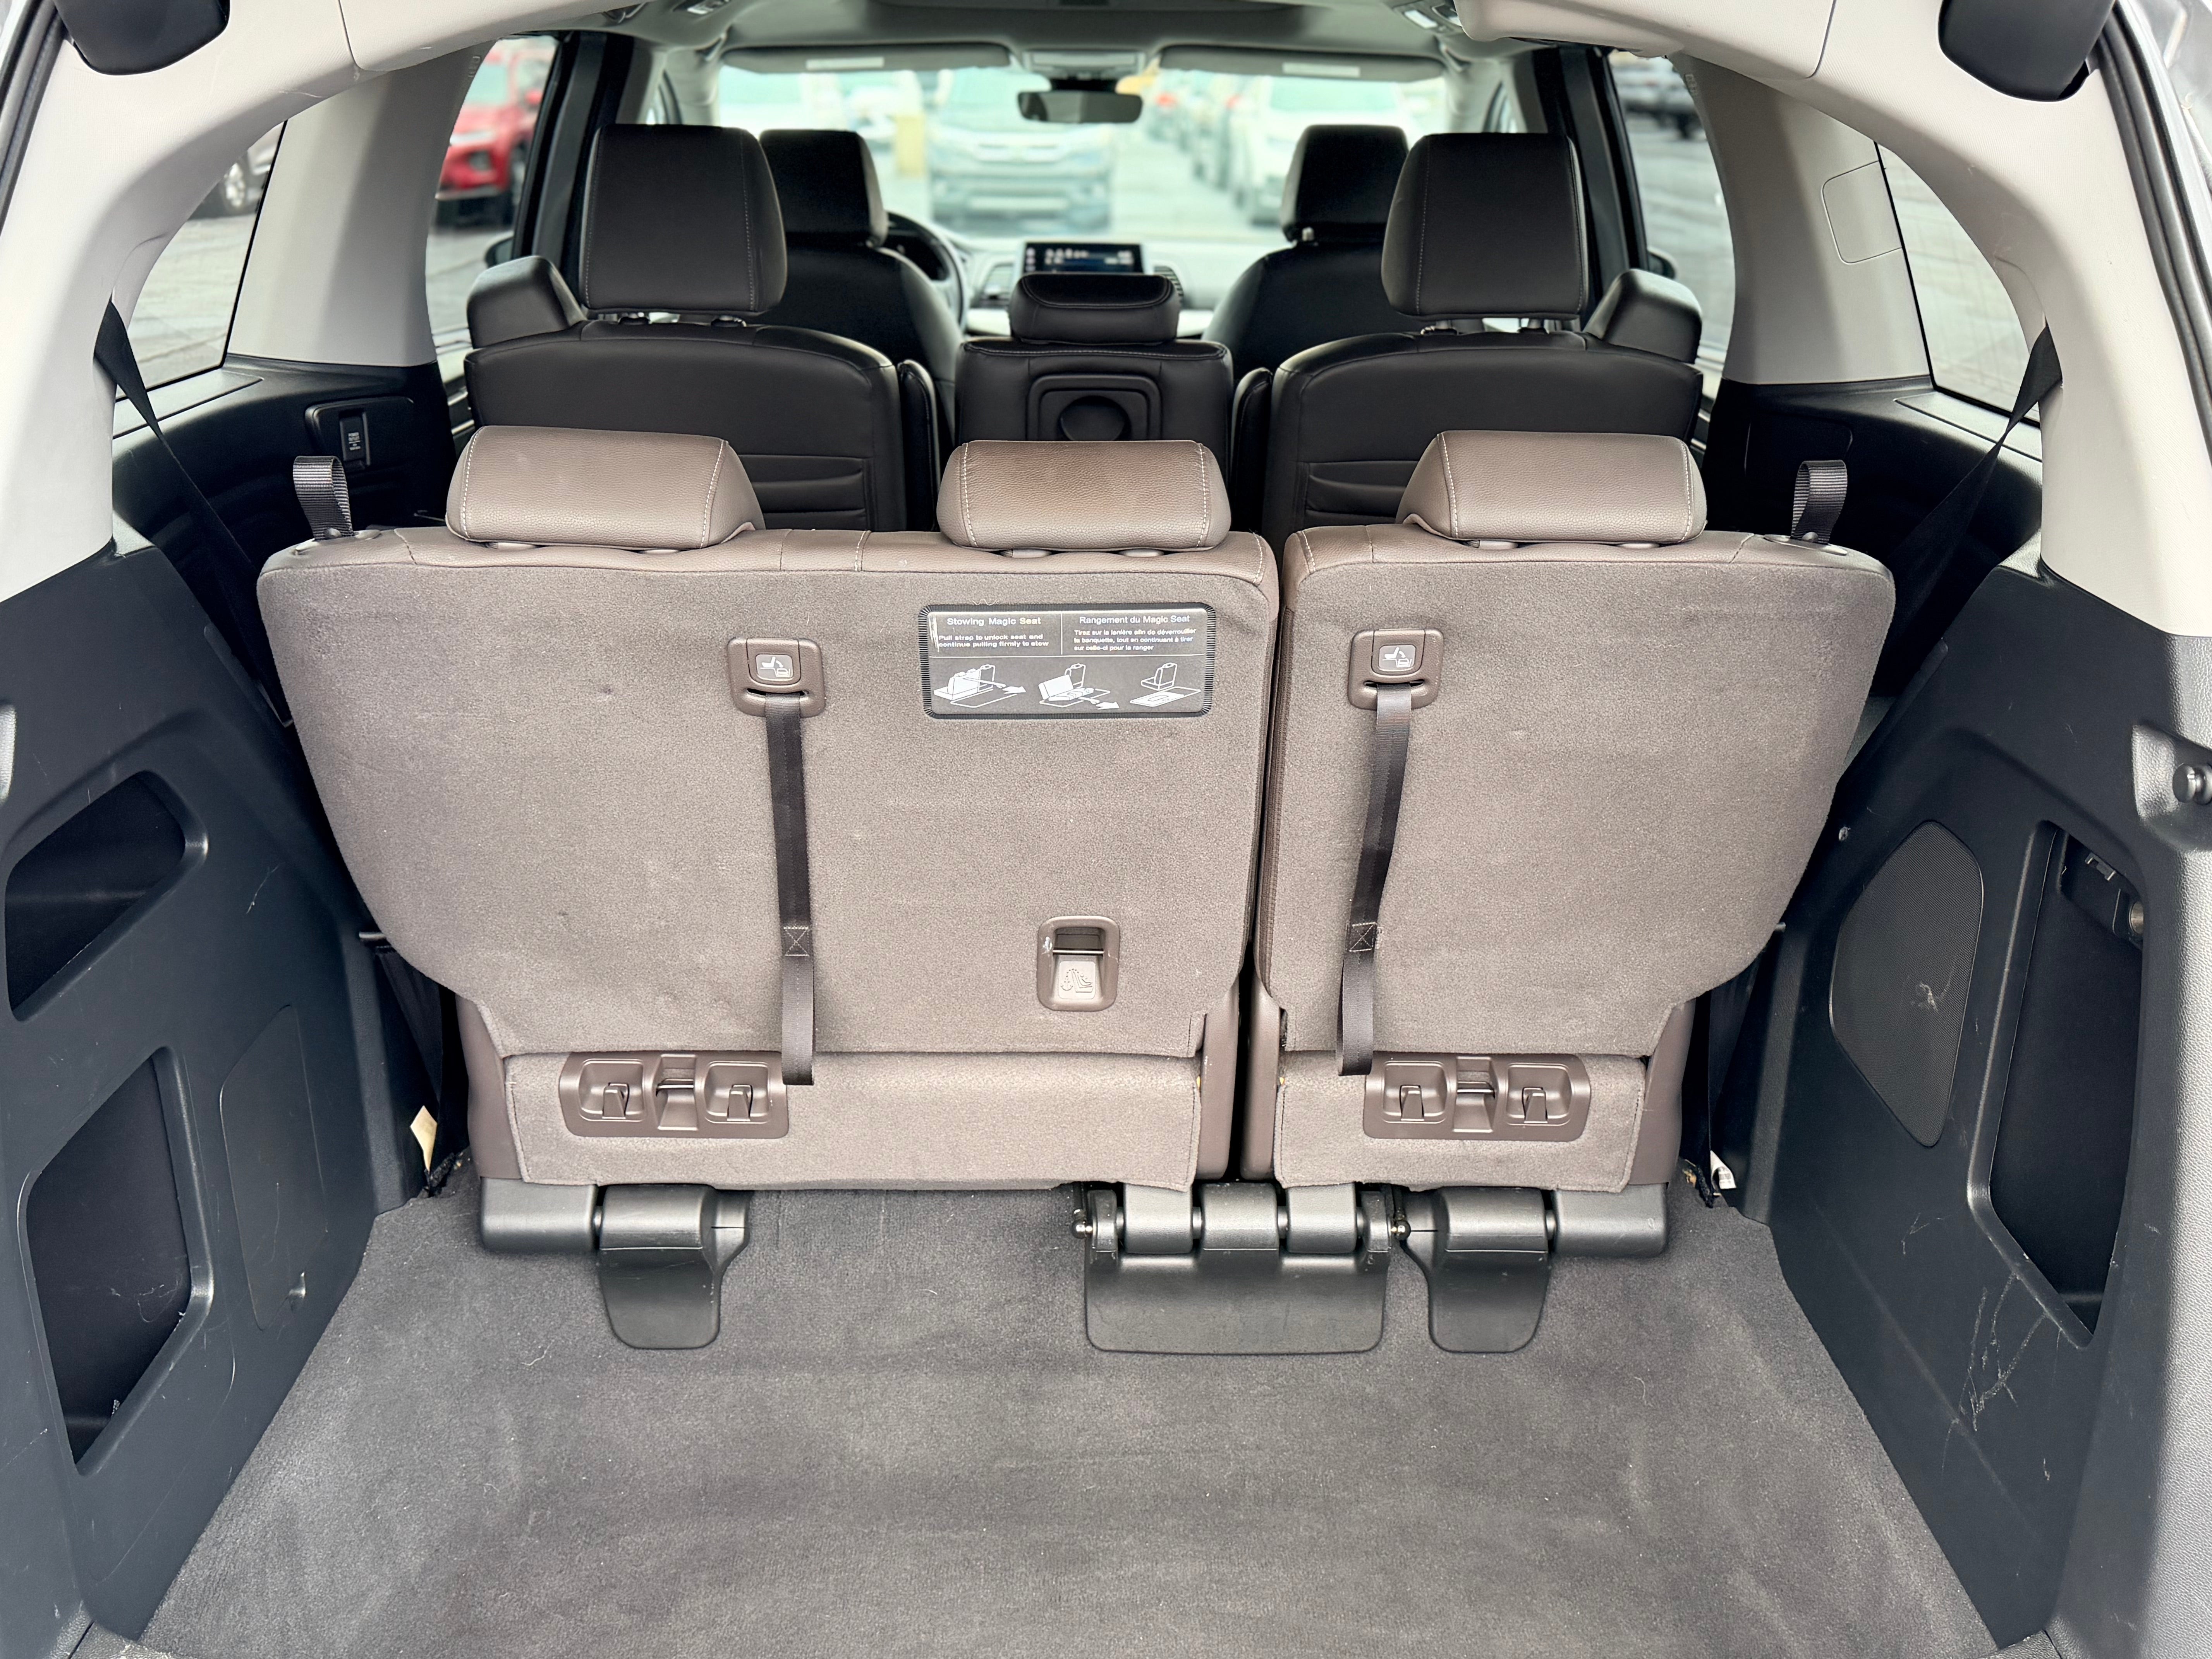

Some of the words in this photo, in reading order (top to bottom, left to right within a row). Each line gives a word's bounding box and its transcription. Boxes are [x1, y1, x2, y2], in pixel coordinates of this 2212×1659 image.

[946, 617, 984, 626] Stowing
[988, 617, 1017, 626] Magic
[1079, 617, 1128, 625] Rangement
[1130, 616, 1140, 624] du
[1143, 615, 1168, 625] Magic
